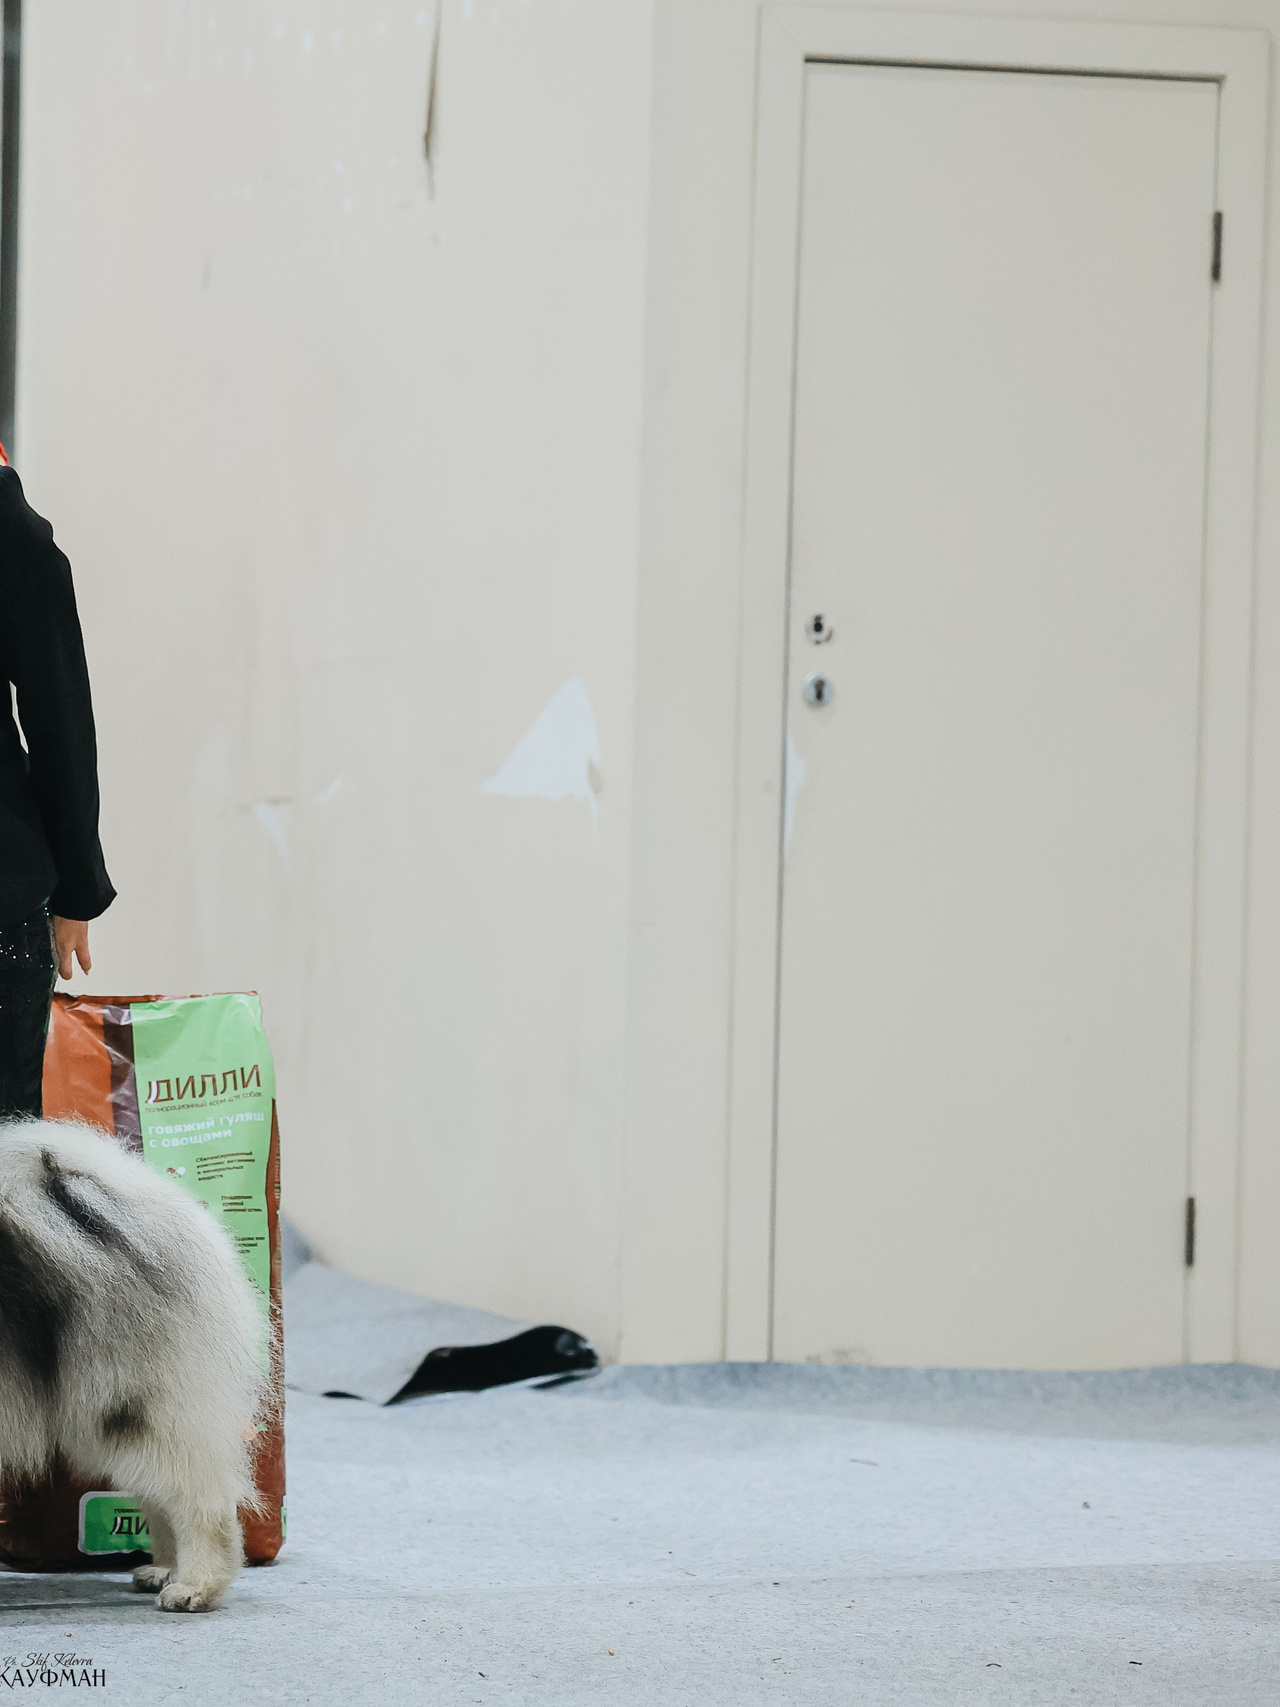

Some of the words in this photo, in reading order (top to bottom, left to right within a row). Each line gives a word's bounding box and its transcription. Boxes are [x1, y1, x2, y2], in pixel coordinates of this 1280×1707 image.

[145, 1064, 262, 1103] ДИЛЛИ
[148, 1117, 215, 1135] говяжий
[219, 1111, 265, 1127] гуляш
[149, 1139, 158, 1148] с
[161, 1129, 232, 1148] овощами
[110, 1516, 150, 1535] ДИ
